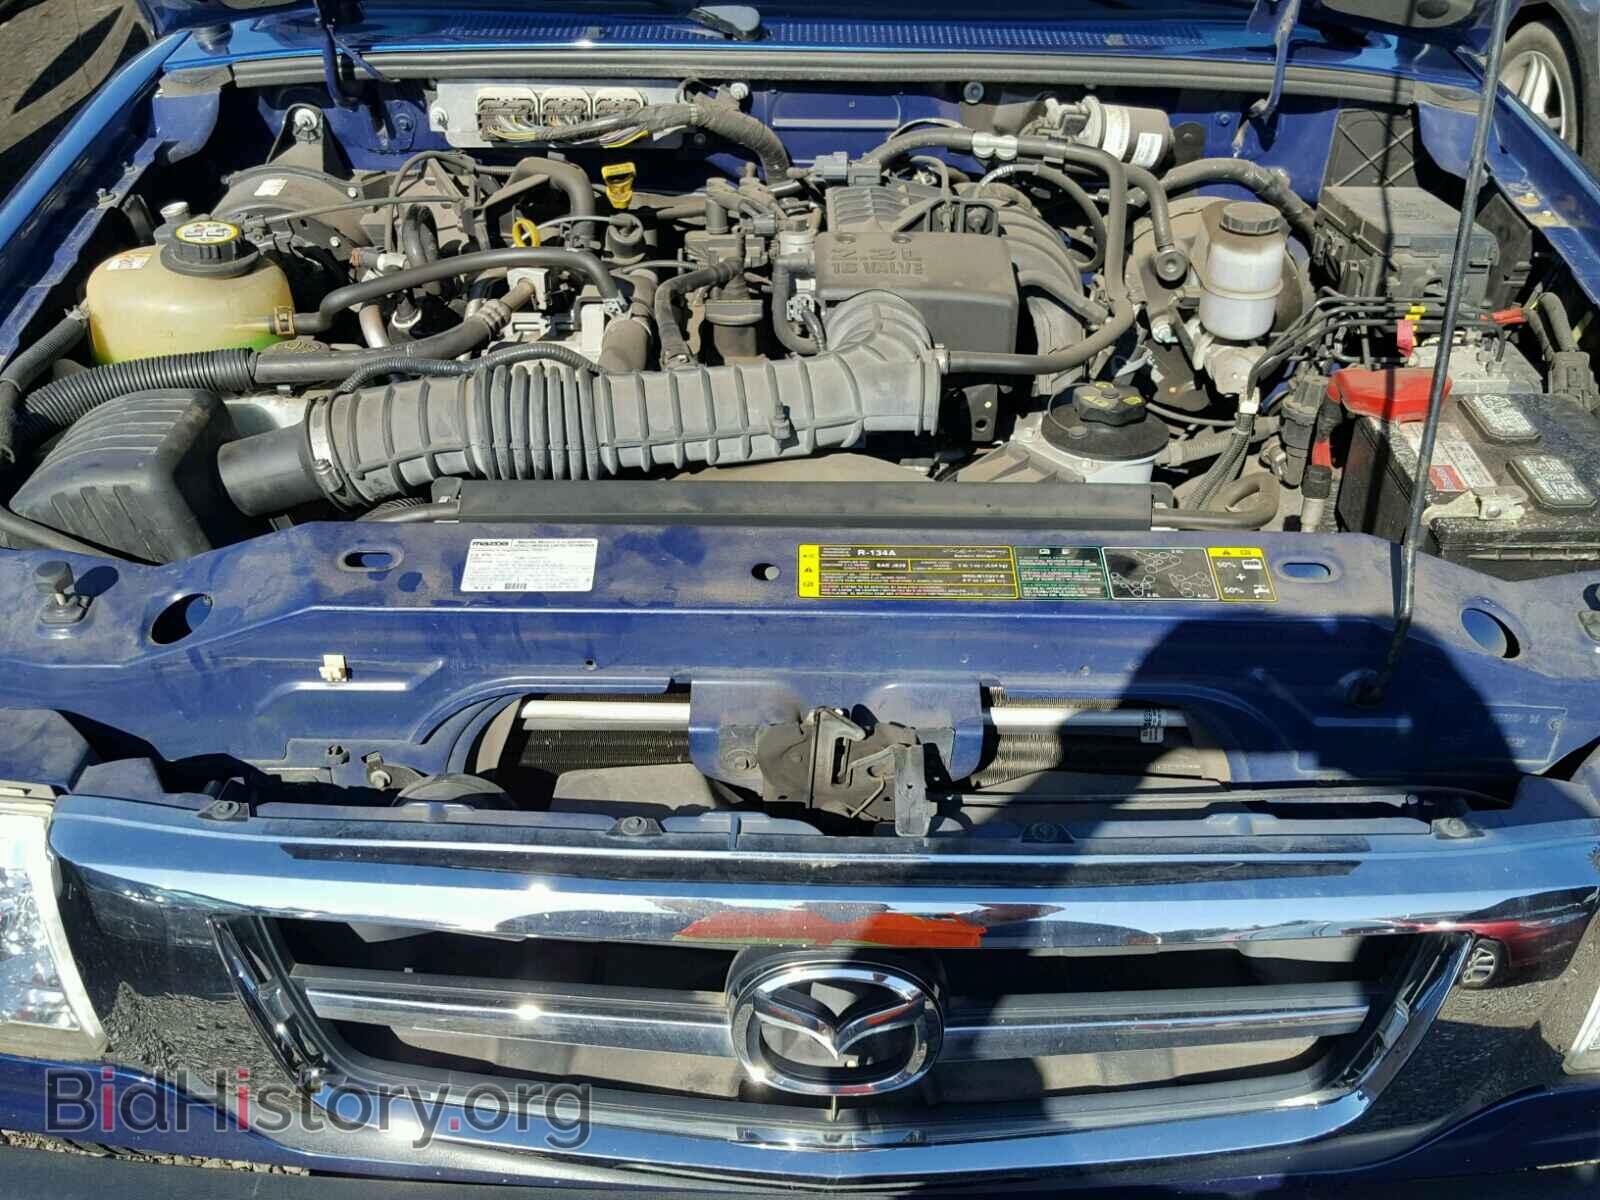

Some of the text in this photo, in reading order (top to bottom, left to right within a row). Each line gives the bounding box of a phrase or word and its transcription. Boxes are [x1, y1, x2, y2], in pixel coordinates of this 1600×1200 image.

[831, 247, 923, 262] 2.3L
[831, 262, 924, 275] 16 VALVE
